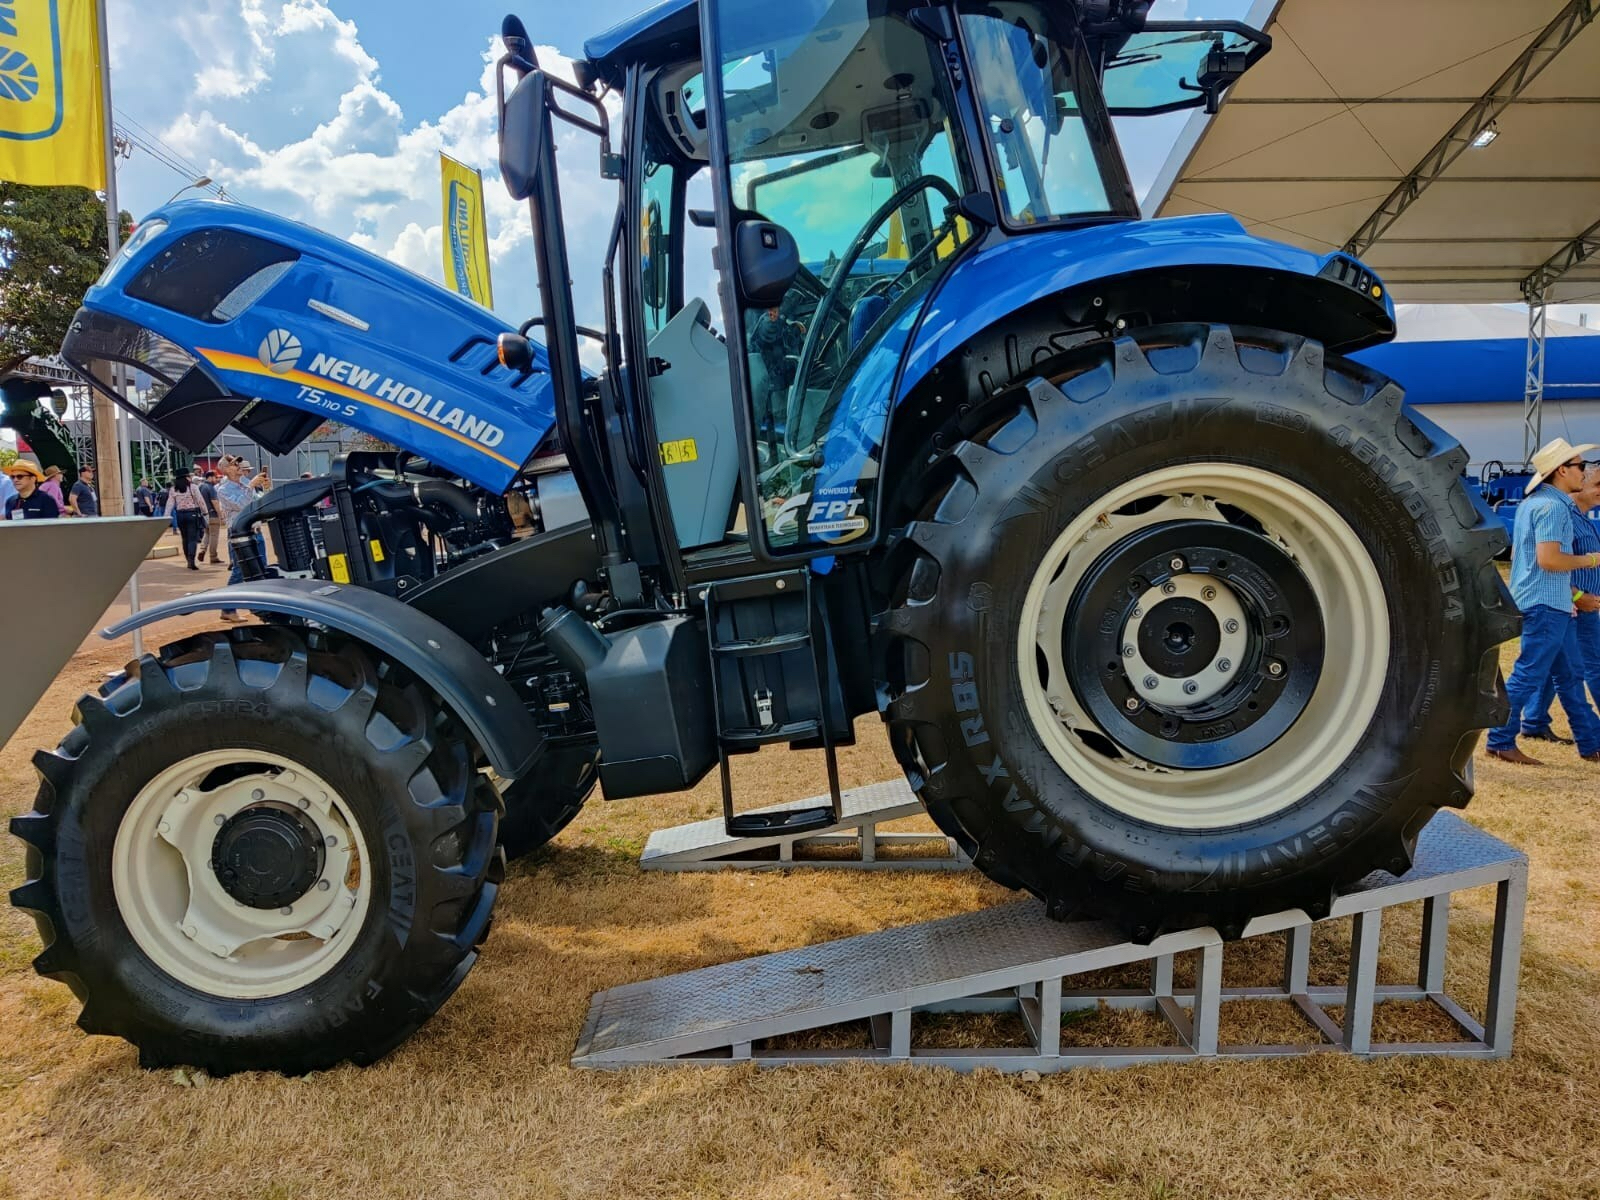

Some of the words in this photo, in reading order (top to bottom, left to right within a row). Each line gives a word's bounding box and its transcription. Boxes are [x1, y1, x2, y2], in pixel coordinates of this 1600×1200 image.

[309, 353, 375, 390] NEW
[376, 376, 505, 448] HOLLAND
[341, 404, 359, 416] S
[806, 498, 865, 521] FPT
[818, 487, 849, 496] POWERED
[948, 651, 991, 748] R85
[388, 833, 414, 907] CEAT
